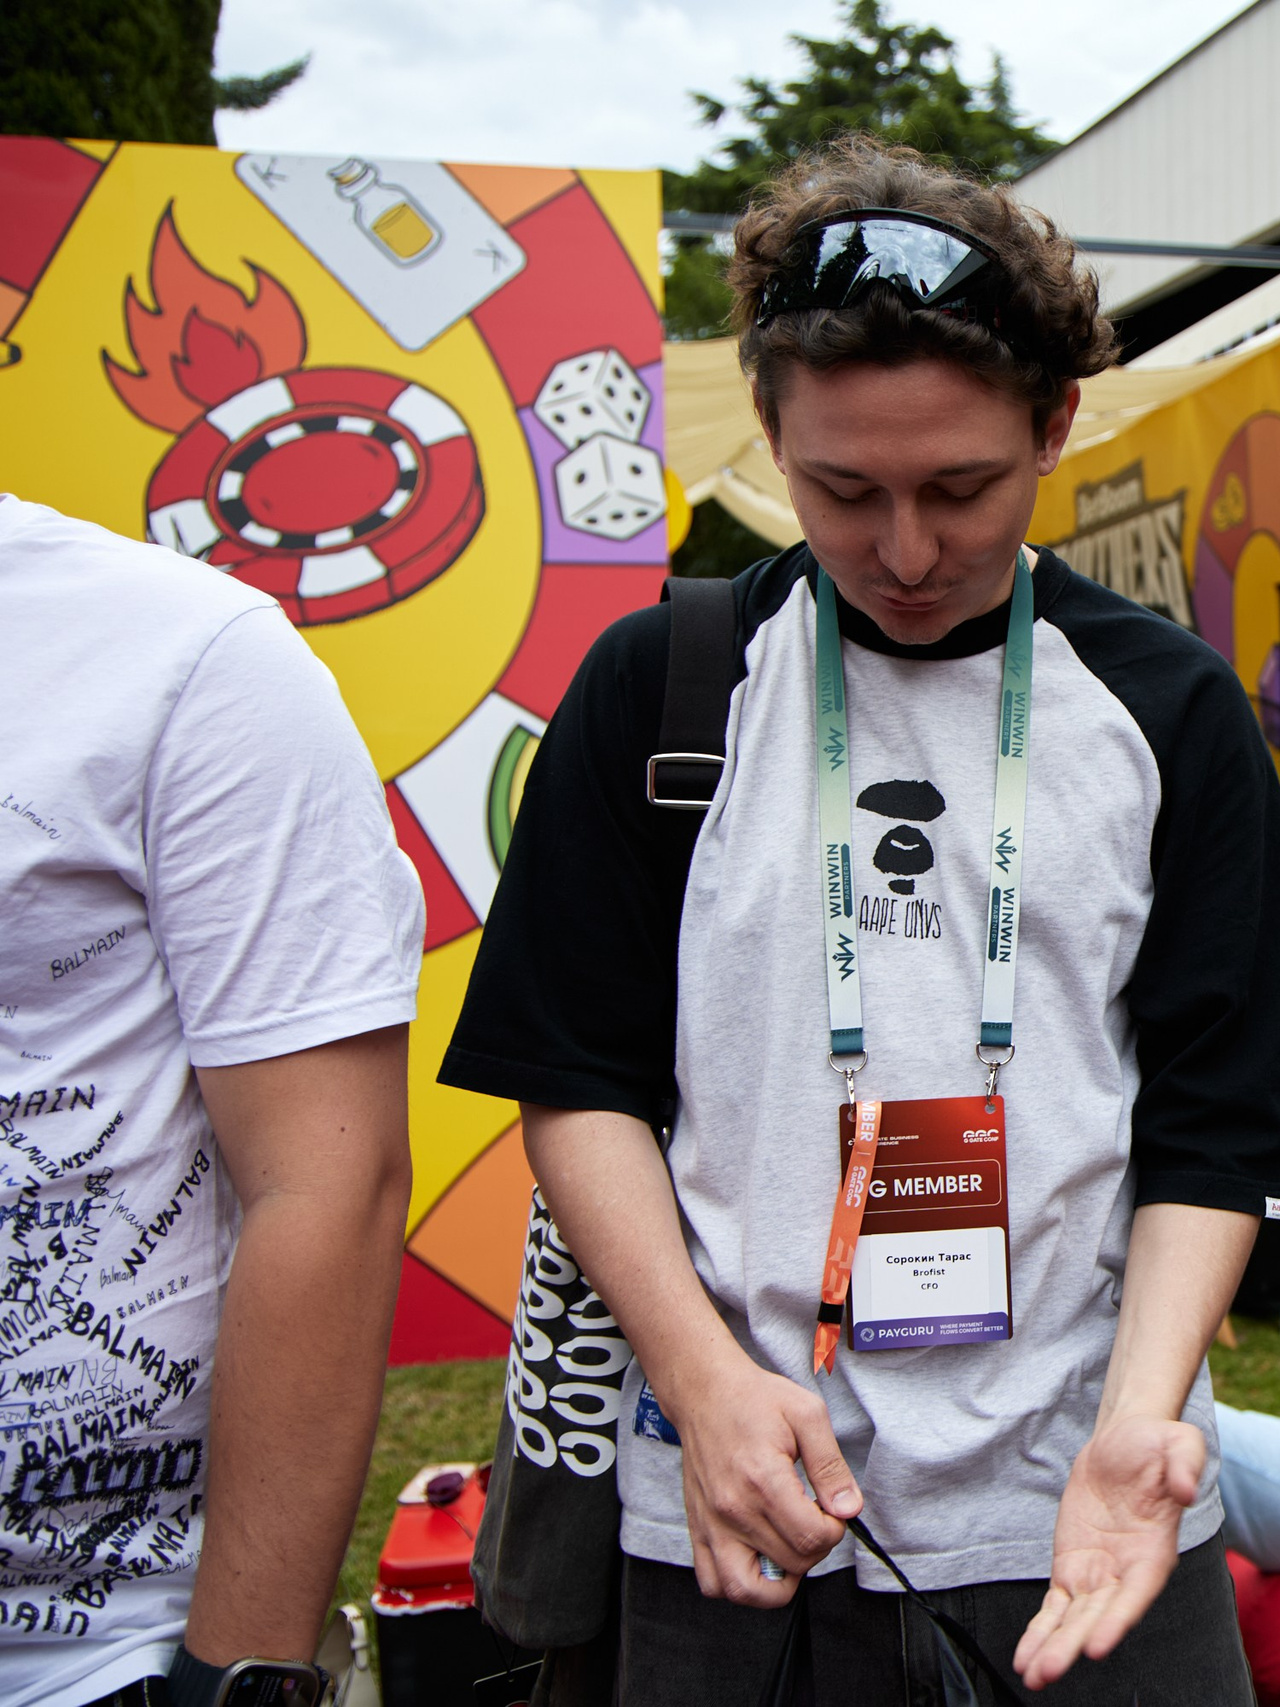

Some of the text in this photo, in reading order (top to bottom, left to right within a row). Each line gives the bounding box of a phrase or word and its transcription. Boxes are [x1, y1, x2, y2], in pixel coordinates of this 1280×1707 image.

[1003, 705, 1011, 741] PARTNERS
[1011, 691, 1026, 759] WINWIN
[826, 843, 842, 919] WINWIN
[859, 895, 898, 935] AAPE
[991, 904, 999, 943] PARTNERS
[998, 887, 1015, 963] WINWIN
[50, 926, 126, 981] BALMAIN
[0, 1084, 95, 1118] MAIN
[860, 1101, 876, 1142] MBER
[0, 1118, 64, 1180] BALMAIN
[61, 1111, 124, 1172] BALMAIN
[893, 1174, 983, 1197] MEMBER
[0, 1199, 90, 1230] MAIN
[122, 1148, 211, 1277] BALMAIN
[886, 1252, 971, 1265] Сорокин Тарас
[913, 1268, 945, 1277] Brofist
[116, 1275, 189, 1319] BALMAIN
[878, 1325, 934, 1339] PAYGURU
[0, 1364, 76, 1400] LMAIN
[29, 1380, 124, 1419] BALMAIN
[72, 1385, 144, 1424] BALMAIN
[0, 1573, 66, 1588] ALMAIN
